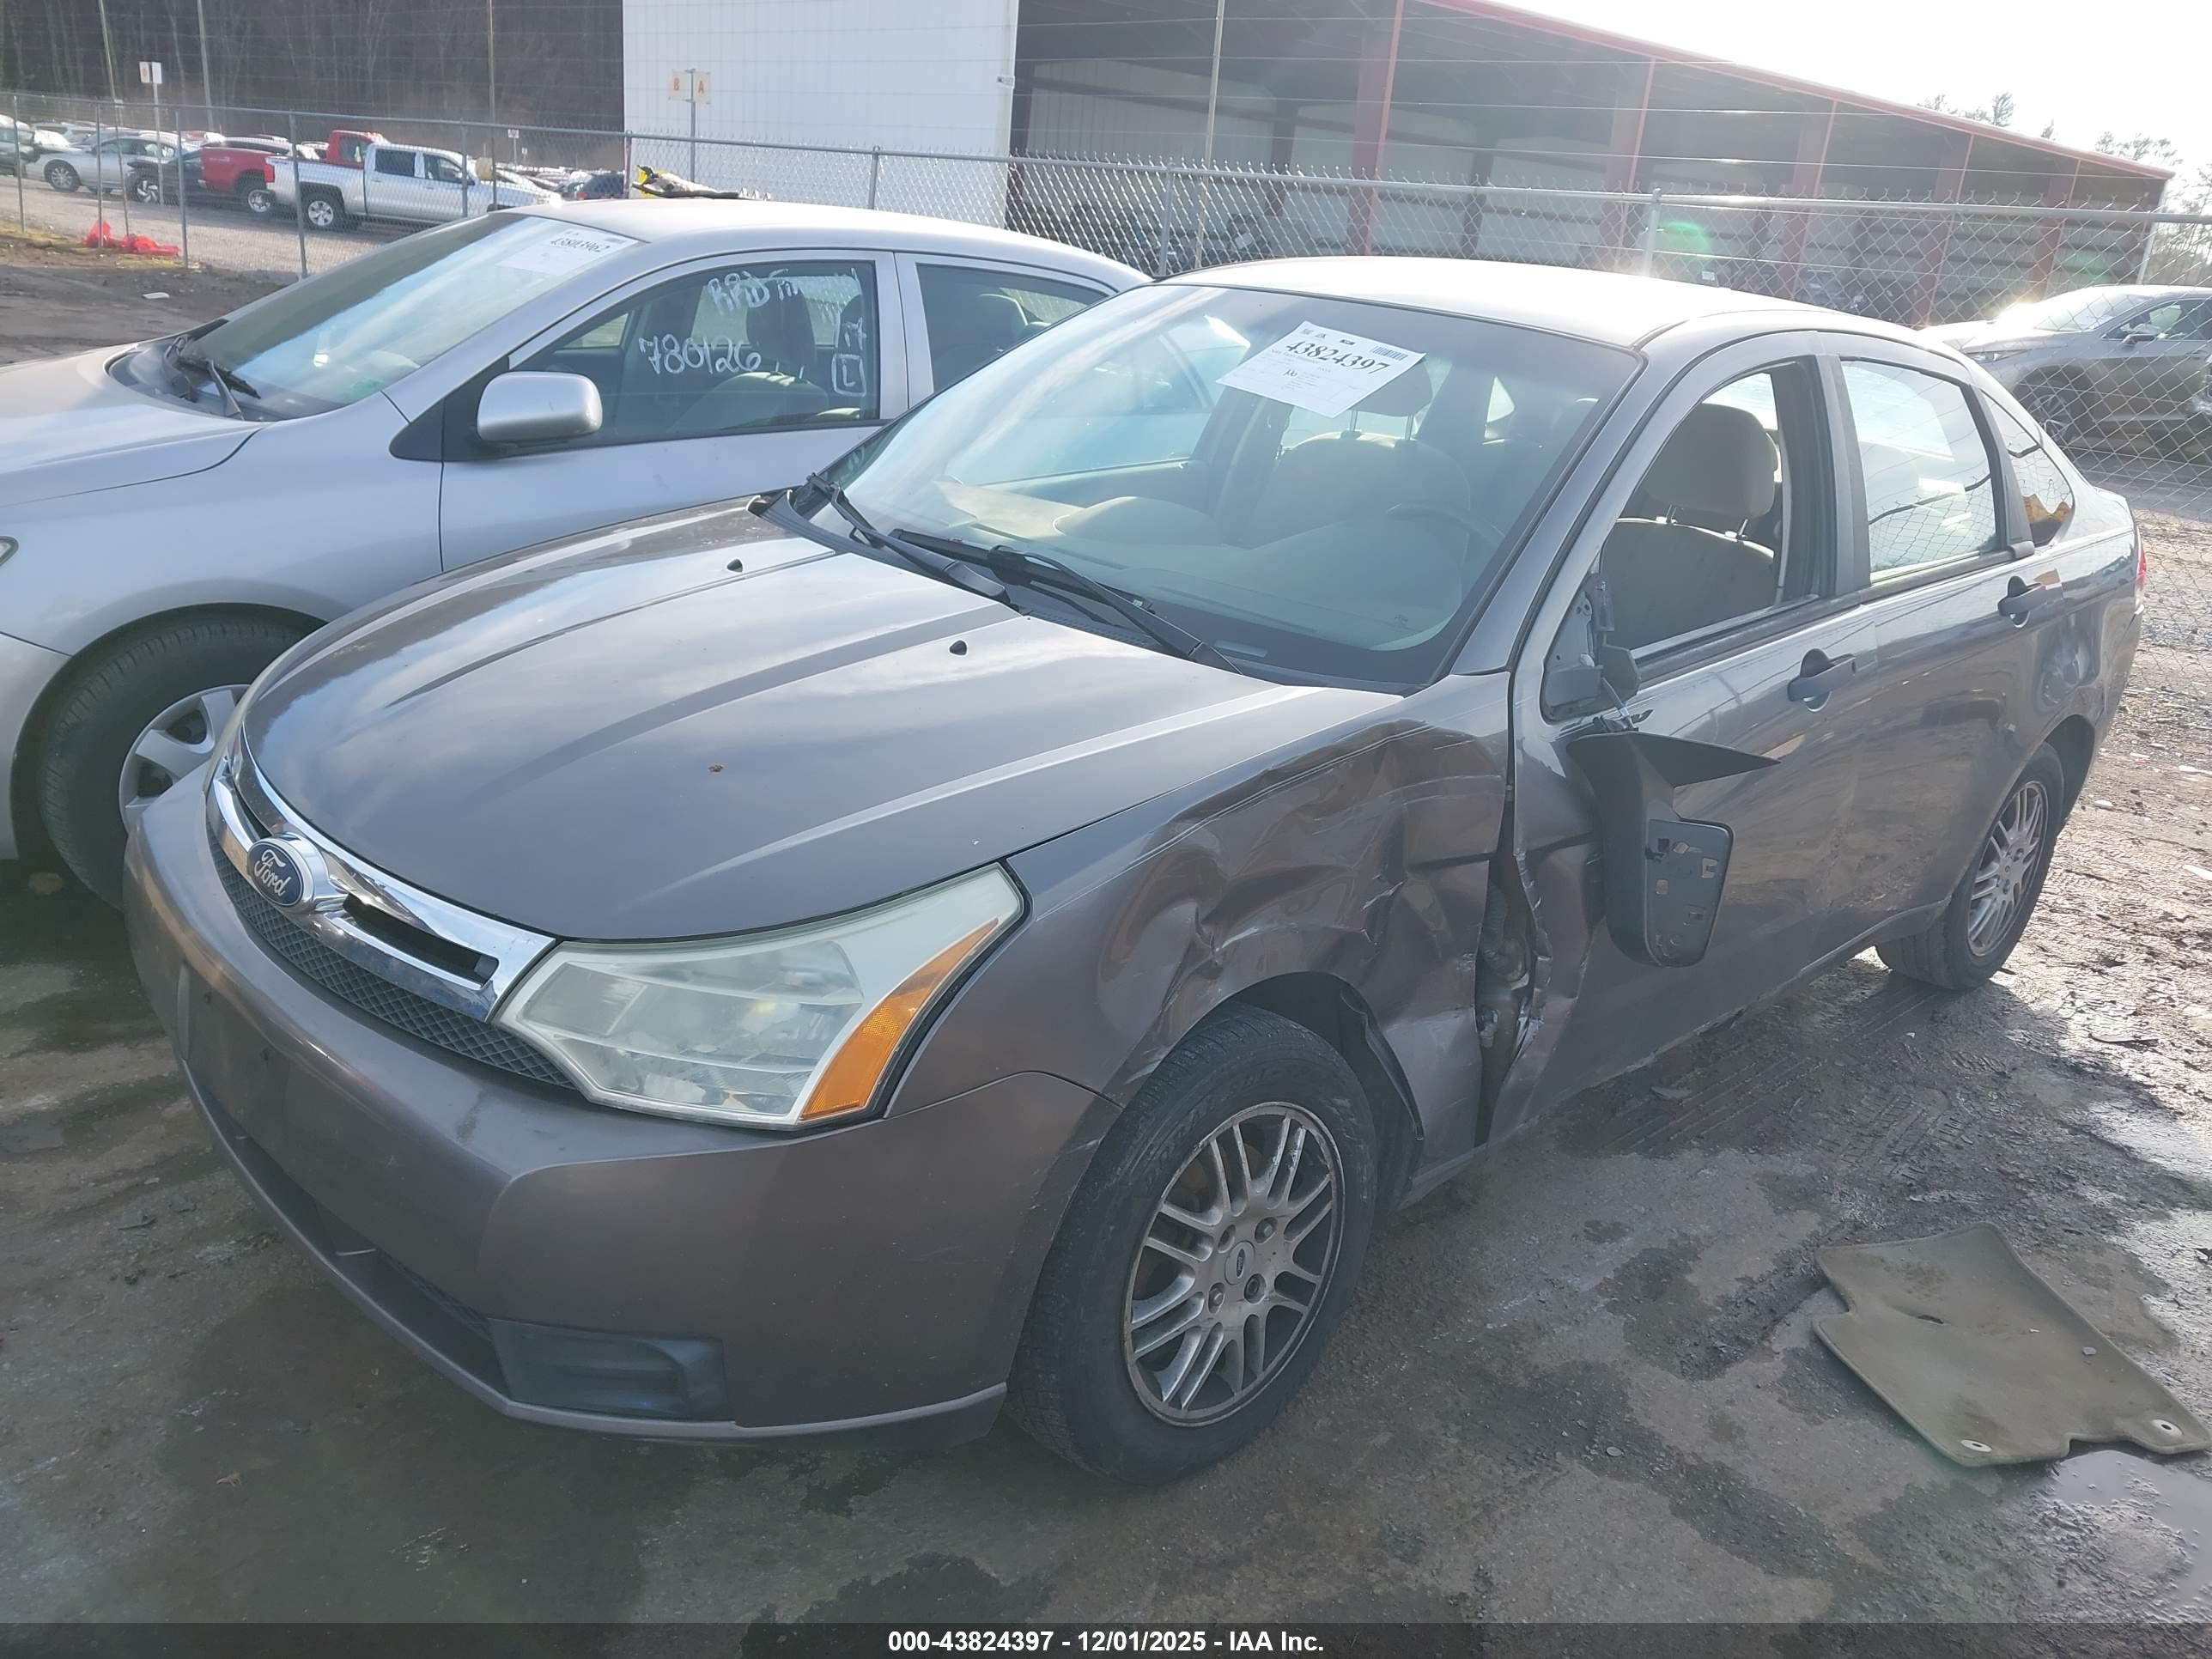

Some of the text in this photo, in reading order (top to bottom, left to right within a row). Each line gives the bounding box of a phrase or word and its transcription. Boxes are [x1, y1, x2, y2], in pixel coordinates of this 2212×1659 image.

[673, 77, 680, 91] B
[697, 81, 705, 94] A
[638, 333, 762, 374] 780126
[1285, 340, 1391, 374] 43824397
[254, 849, 291, 896] Ford
